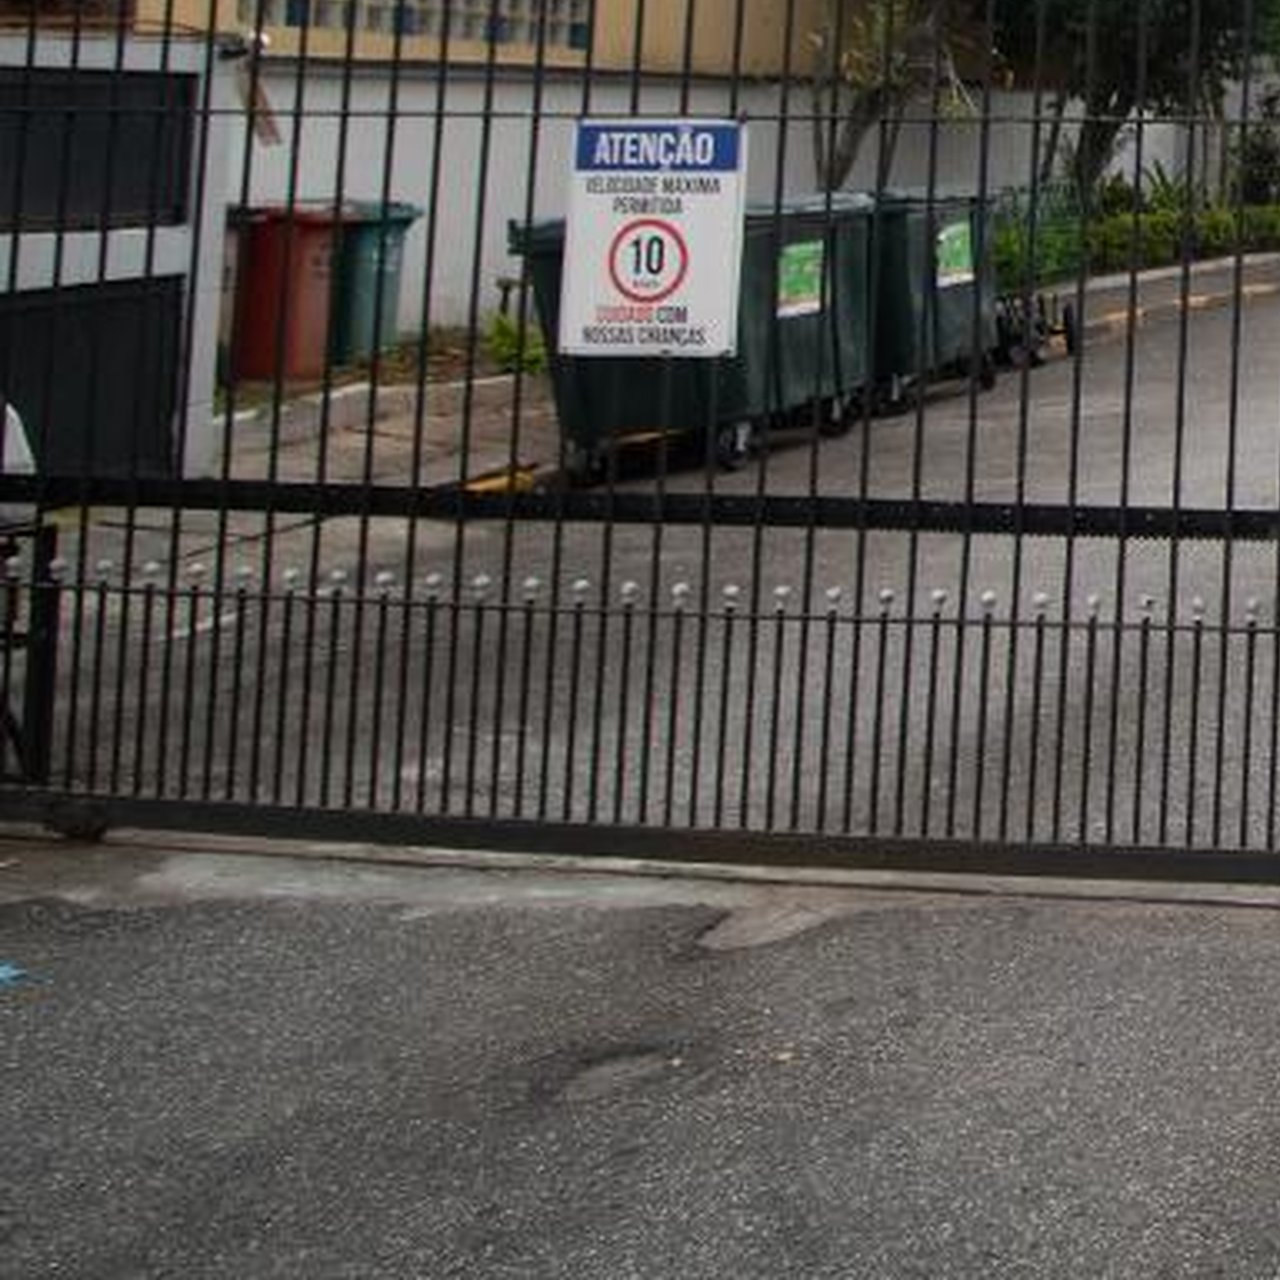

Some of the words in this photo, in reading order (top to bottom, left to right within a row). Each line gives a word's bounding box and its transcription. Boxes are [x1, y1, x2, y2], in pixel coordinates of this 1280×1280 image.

[594, 125, 715, 171] ATENÇÃO
[586, 176, 658, 194] VELOCIDADE
[612, 196, 683, 214] PERMITIDA
[631, 236, 664, 275] 10
[656, 306, 688, 323] COM
[582, 325, 634, 344] NOSSAS
